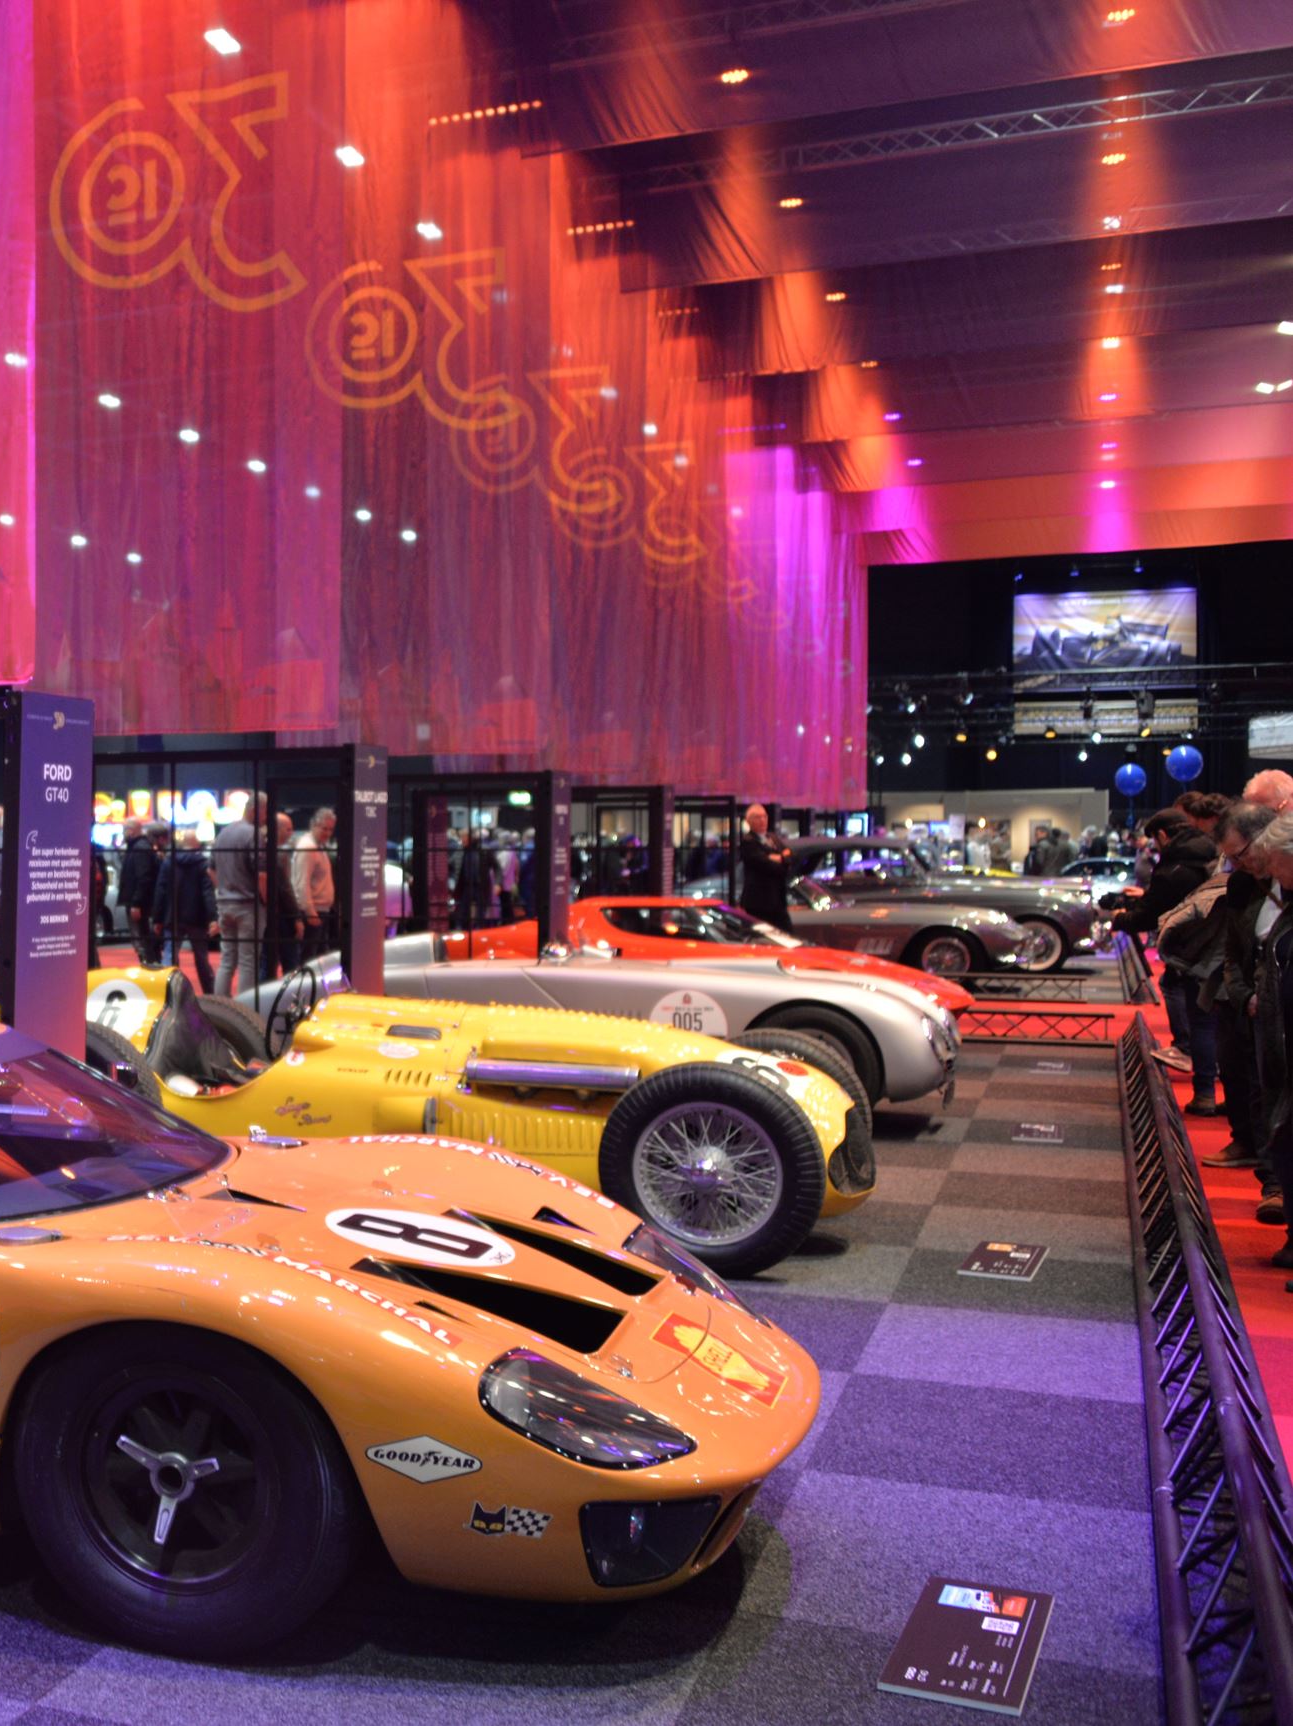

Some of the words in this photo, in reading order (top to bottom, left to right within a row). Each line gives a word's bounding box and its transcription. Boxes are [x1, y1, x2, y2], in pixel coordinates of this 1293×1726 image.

[43, 763, 72, 781] FORD
[45, 786, 69, 802] GT40
[672, 1012, 703, 1032] 005
[336, 1213, 493, 1259] 8
[273, 1255, 452, 1345] MARCHAL
[373, 1448, 477, 1470] GOODYEAR
